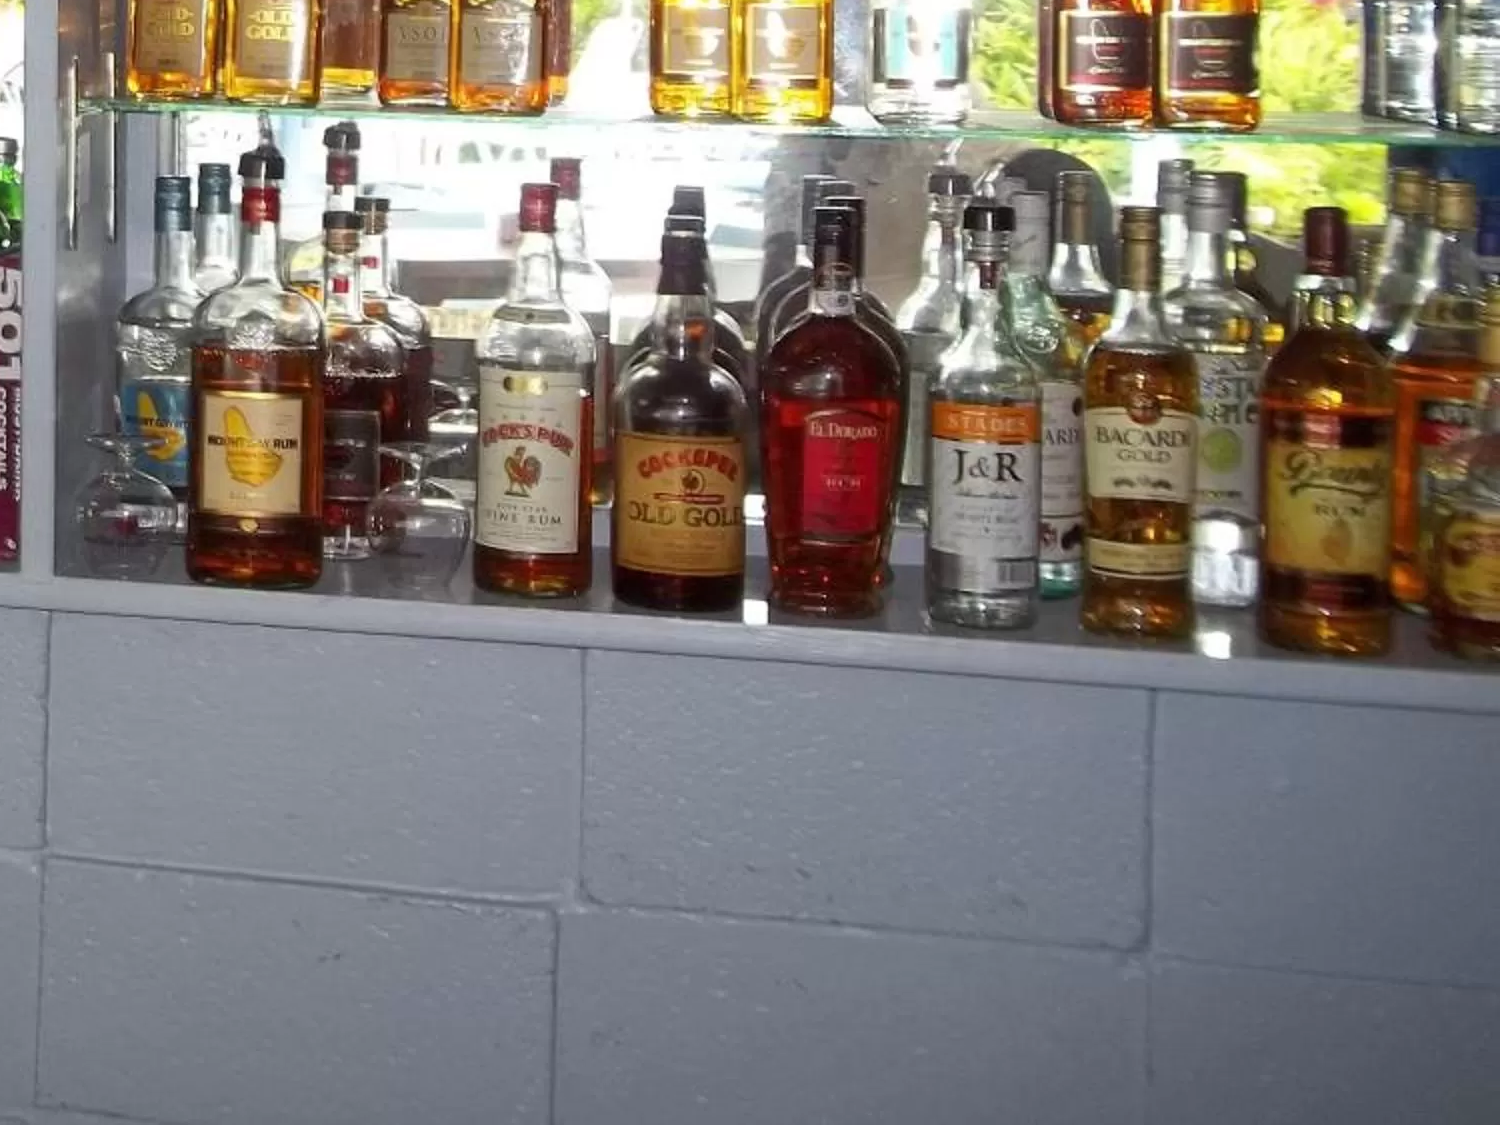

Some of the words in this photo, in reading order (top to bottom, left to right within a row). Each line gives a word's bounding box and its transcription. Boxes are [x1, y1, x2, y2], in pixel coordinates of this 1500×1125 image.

[272, 438, 299, 450] RUM
[1094, 425, 1192, 449] BACARDI
[1116, 448, 1173, 463] GOLD
[952, 448, 1024, 487] J&R
[527, 514, 562, 526] RUM
[627, 500, 676, 526] OLD
